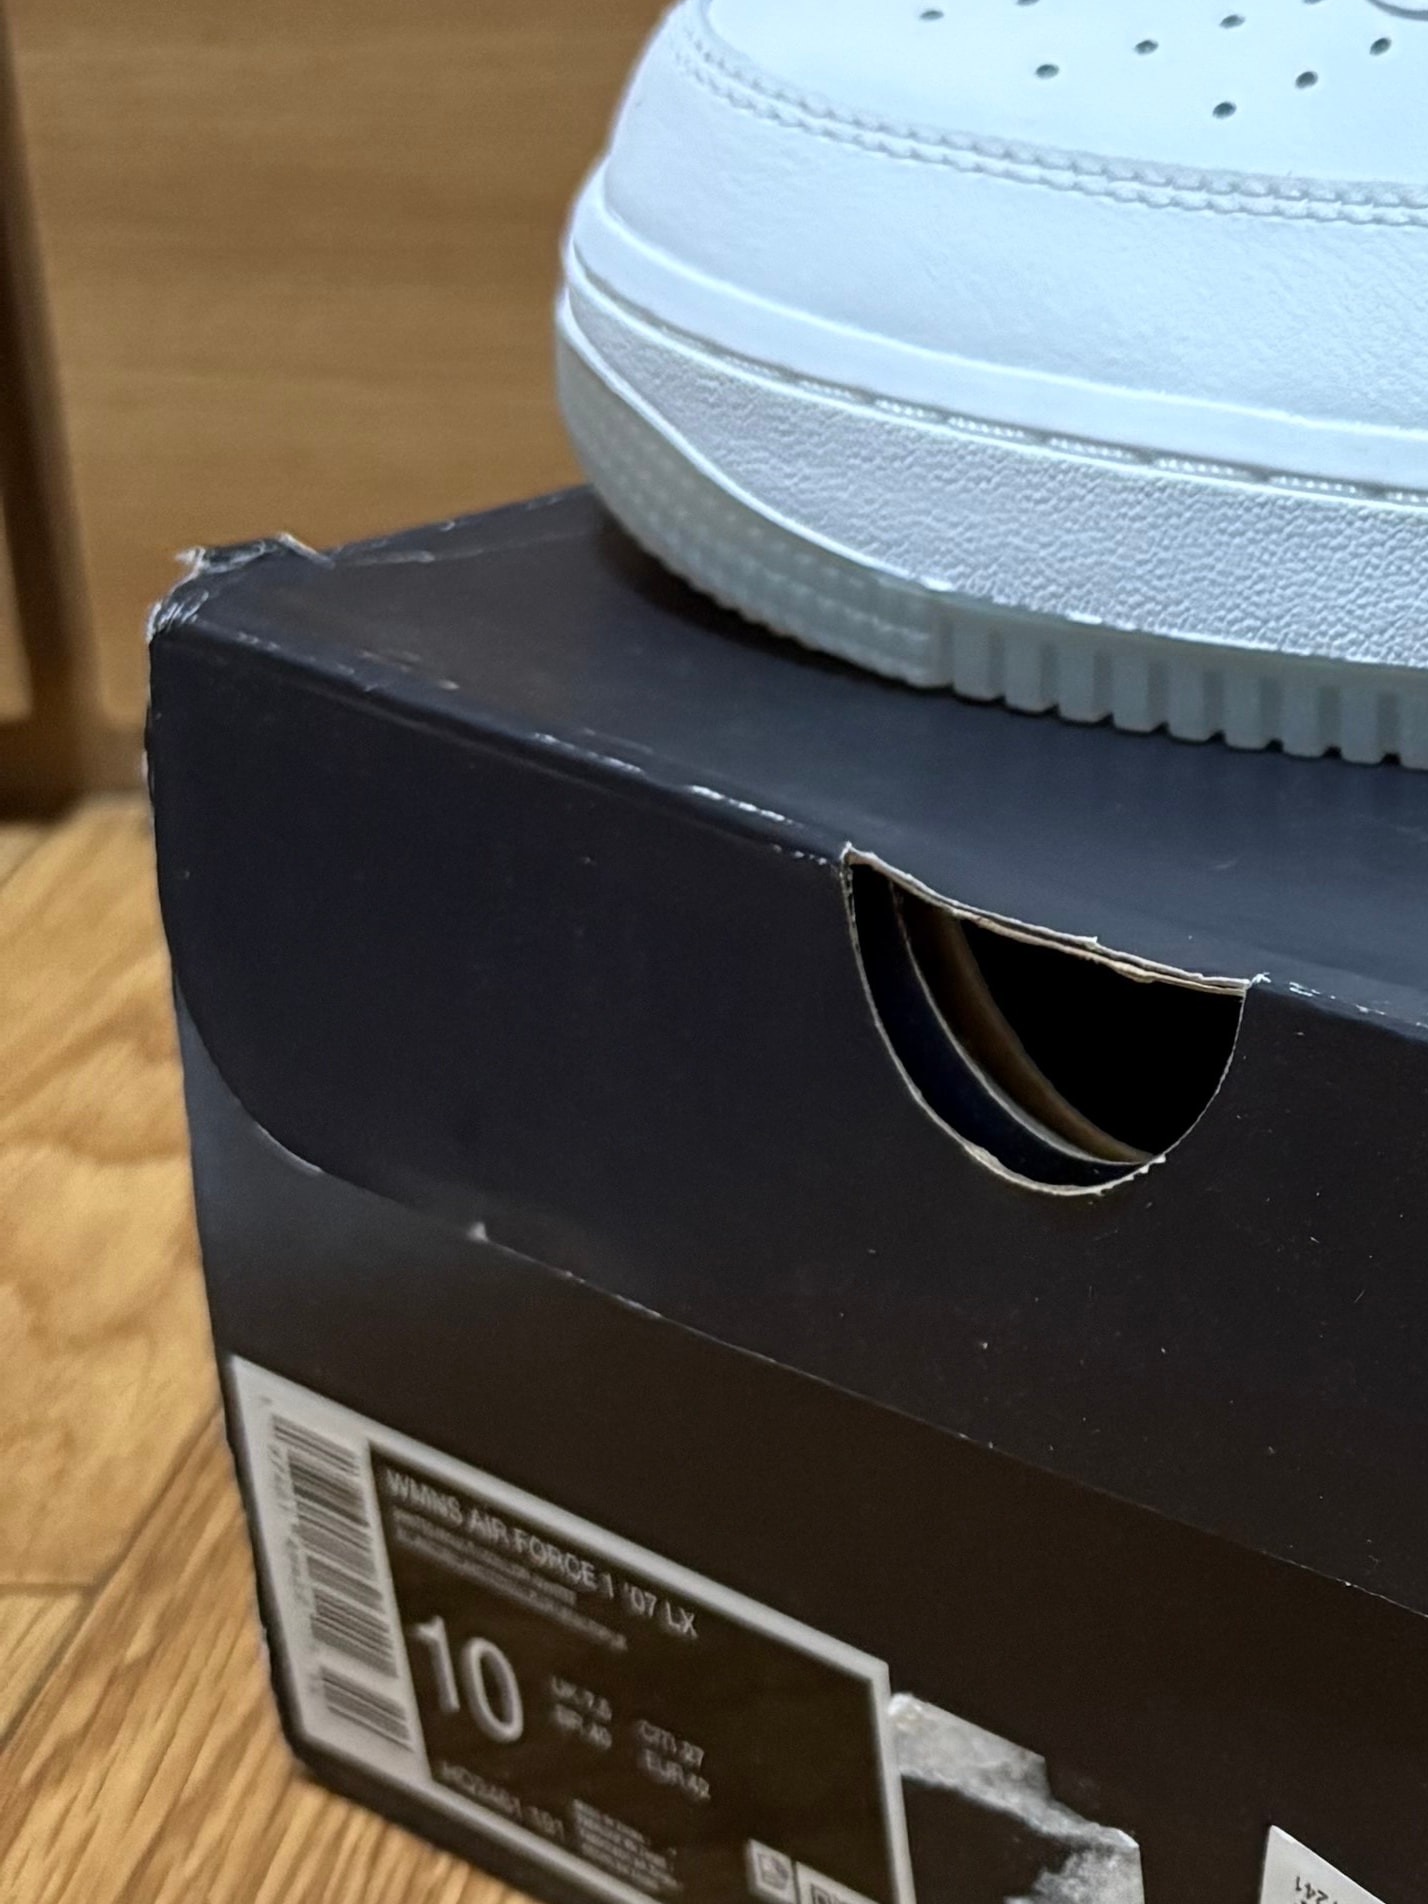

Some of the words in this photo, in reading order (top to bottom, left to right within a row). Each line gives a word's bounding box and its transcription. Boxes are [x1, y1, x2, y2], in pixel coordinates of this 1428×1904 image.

[386, 1468, 464, 1528] WMNS
[465, 1506, 511, 1545] AIR
[511, 1526, 599, 1594] FORCE
[663, 1599, 699, 1641] LX
[410, 1612, 524, 1744] 10
